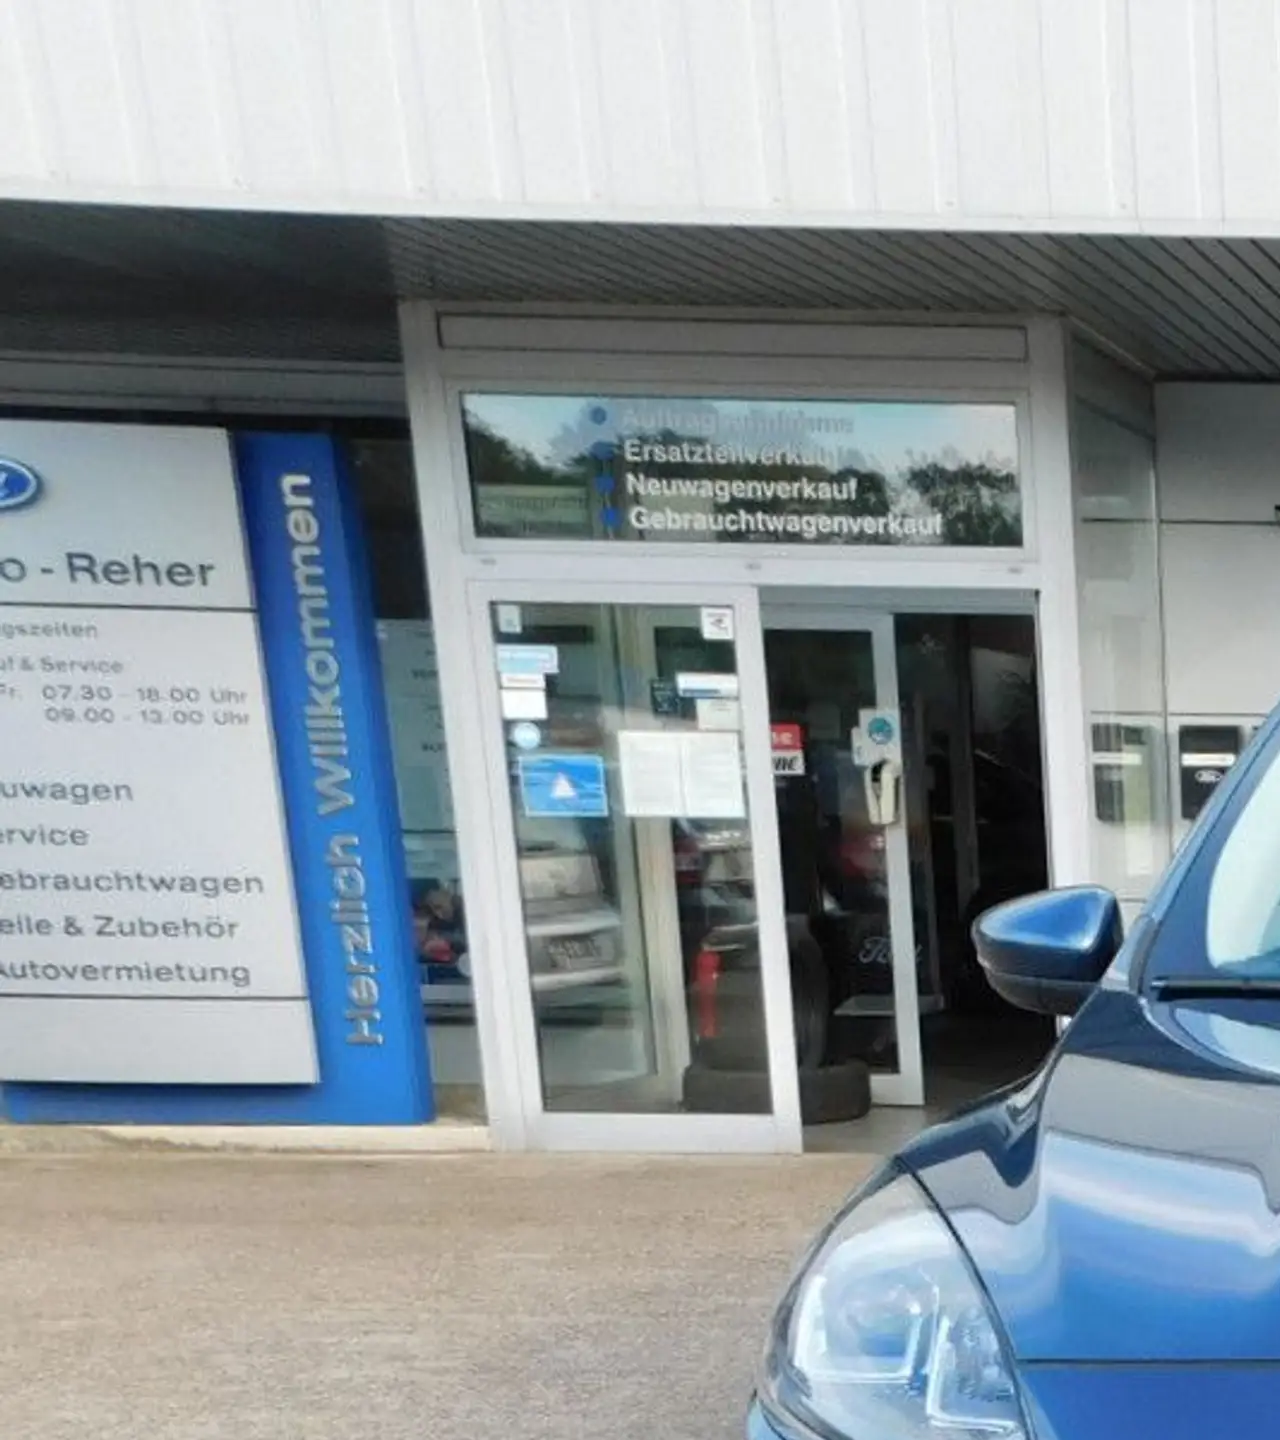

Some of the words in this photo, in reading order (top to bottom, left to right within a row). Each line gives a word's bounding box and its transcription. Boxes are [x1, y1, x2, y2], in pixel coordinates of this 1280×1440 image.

[626, 472, 858, 503] Neuwagenverkauf
[629, 505, 943, 540] Gebrauchtwagenverkauf
[65, 551, 216, 587] Reher
[0, 621, 99, 639] gszeiten
[280, 474, 354, 815] Willkommen
[40, 655, 124, 674] Service
[210, 687, 248, 704] Uhr
[213, 709, 250, 726] Uhr
[0, 780, 134, 804] uwagen
[0, 825, 90, 846] rvice
[0, 868, 265, 897] ebrauchtwagen
[63, 916, 83, 937] &
[94, 914, 240, 940] Zubehör
[325, 834, 384, 1046] Herzlich
